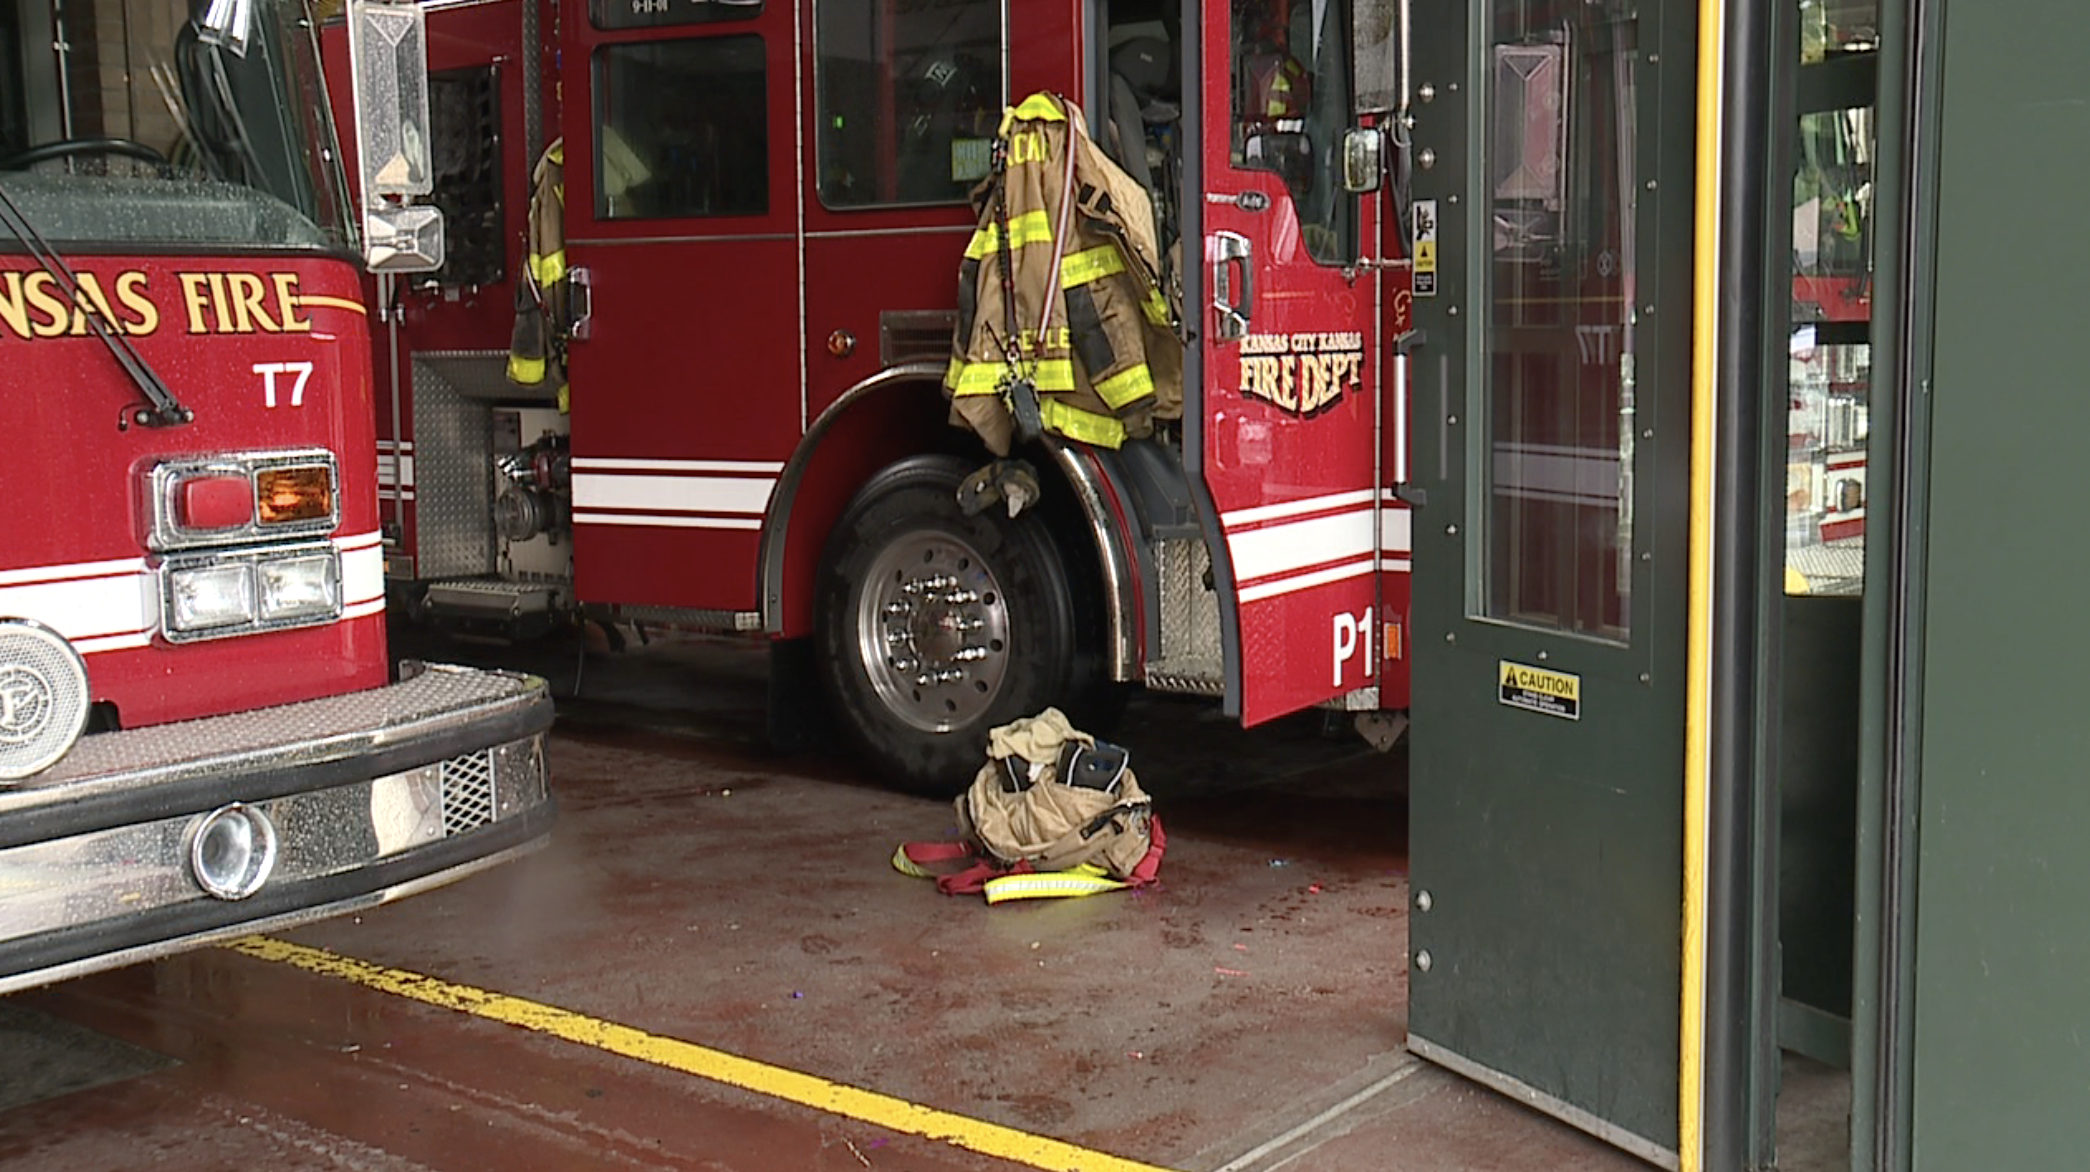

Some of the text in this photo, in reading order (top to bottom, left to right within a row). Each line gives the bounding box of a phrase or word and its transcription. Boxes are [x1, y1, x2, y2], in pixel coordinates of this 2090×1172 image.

[178, 272, 311, 334] FIRE
[1239, 331, 1362, 354] KANSAS CITY KANSAS
[253, 361, 313, 407] T7
[1239, 352, 1362, 413] FIRE DEPT
[1333, 606, 1373, 687] P1
[1520, 671, 1574, 696] CAUTION
